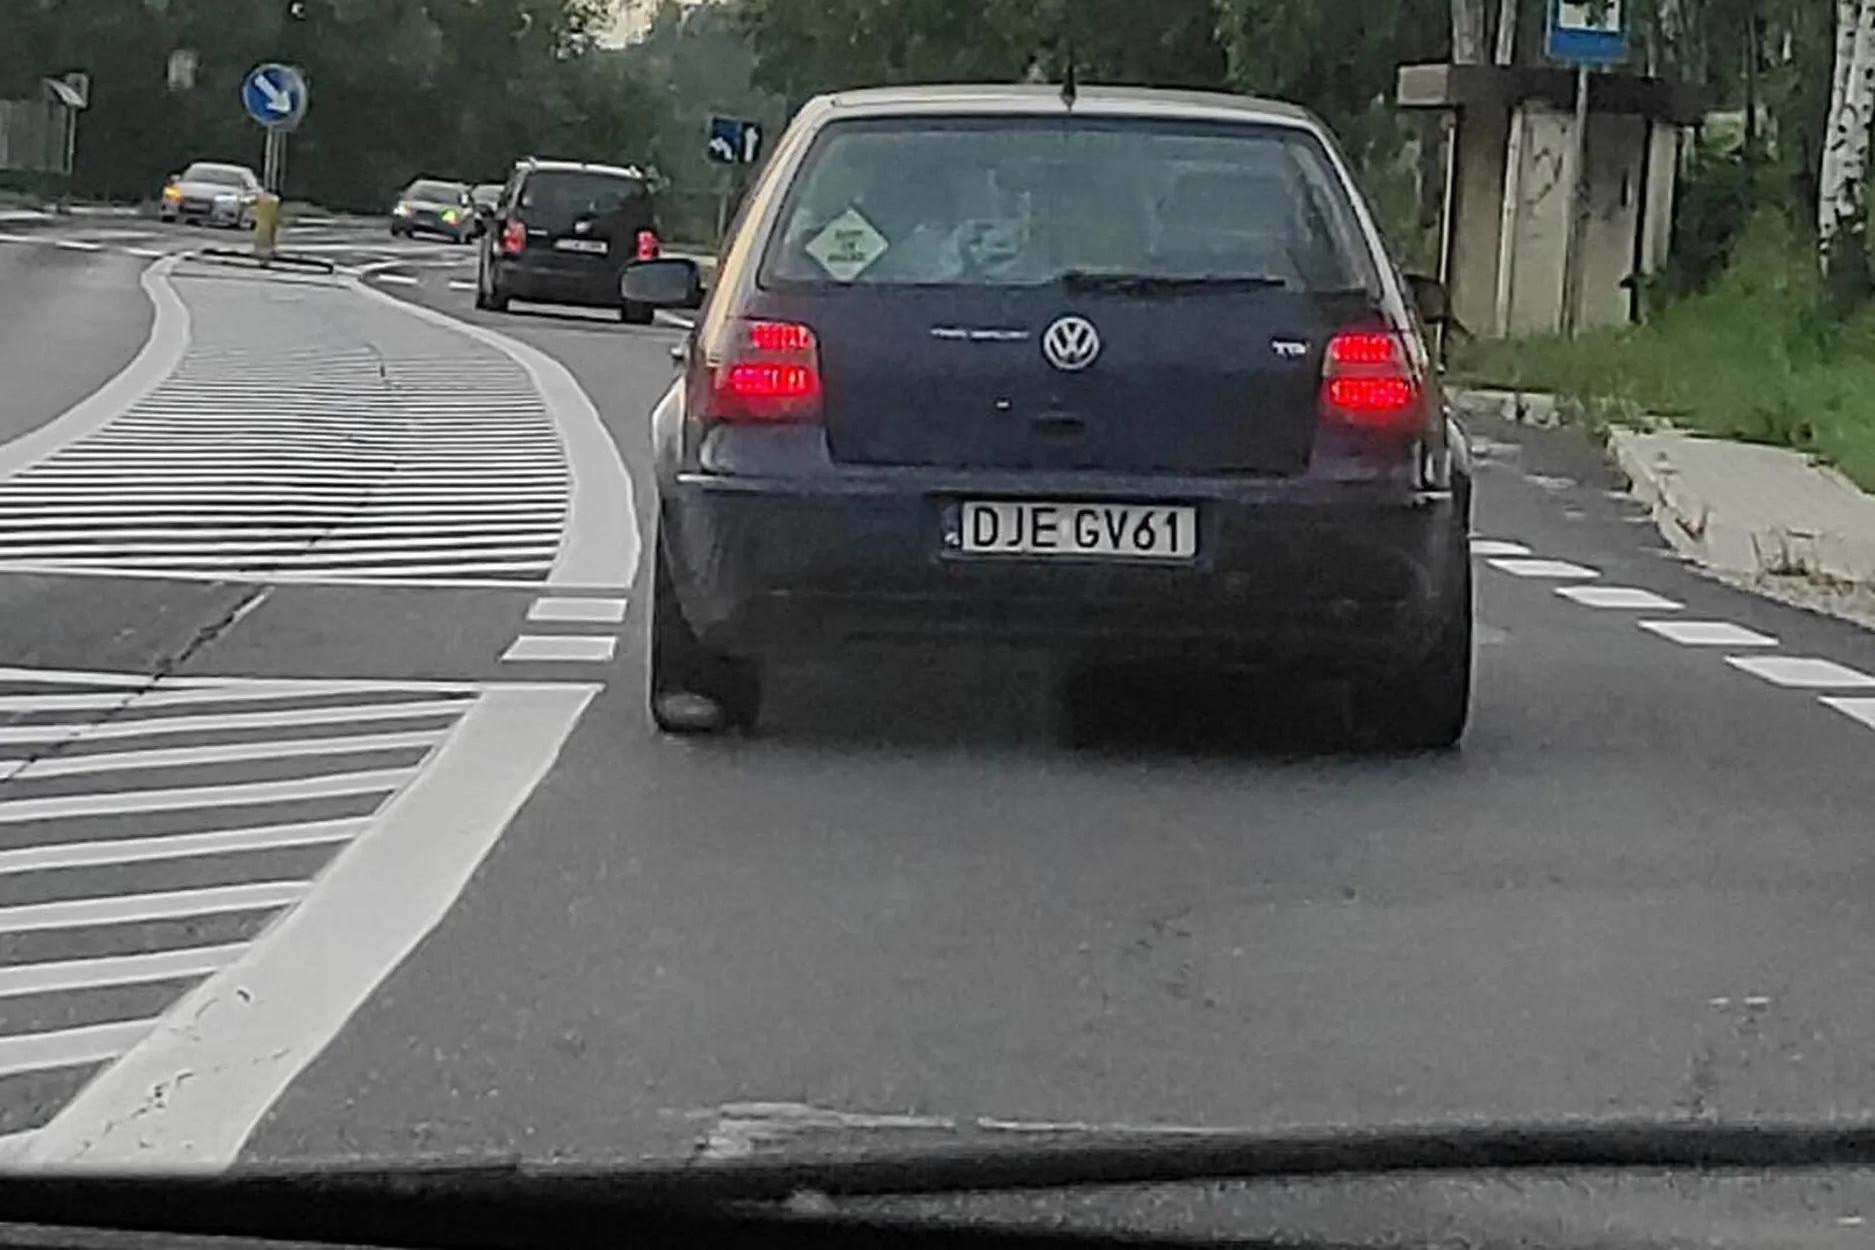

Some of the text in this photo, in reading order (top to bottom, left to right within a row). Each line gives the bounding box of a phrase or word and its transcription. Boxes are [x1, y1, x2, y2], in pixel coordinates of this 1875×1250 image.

[1045, 317, 1099, 368] VW
[973, 506, 1178, 552] DJE GV61
